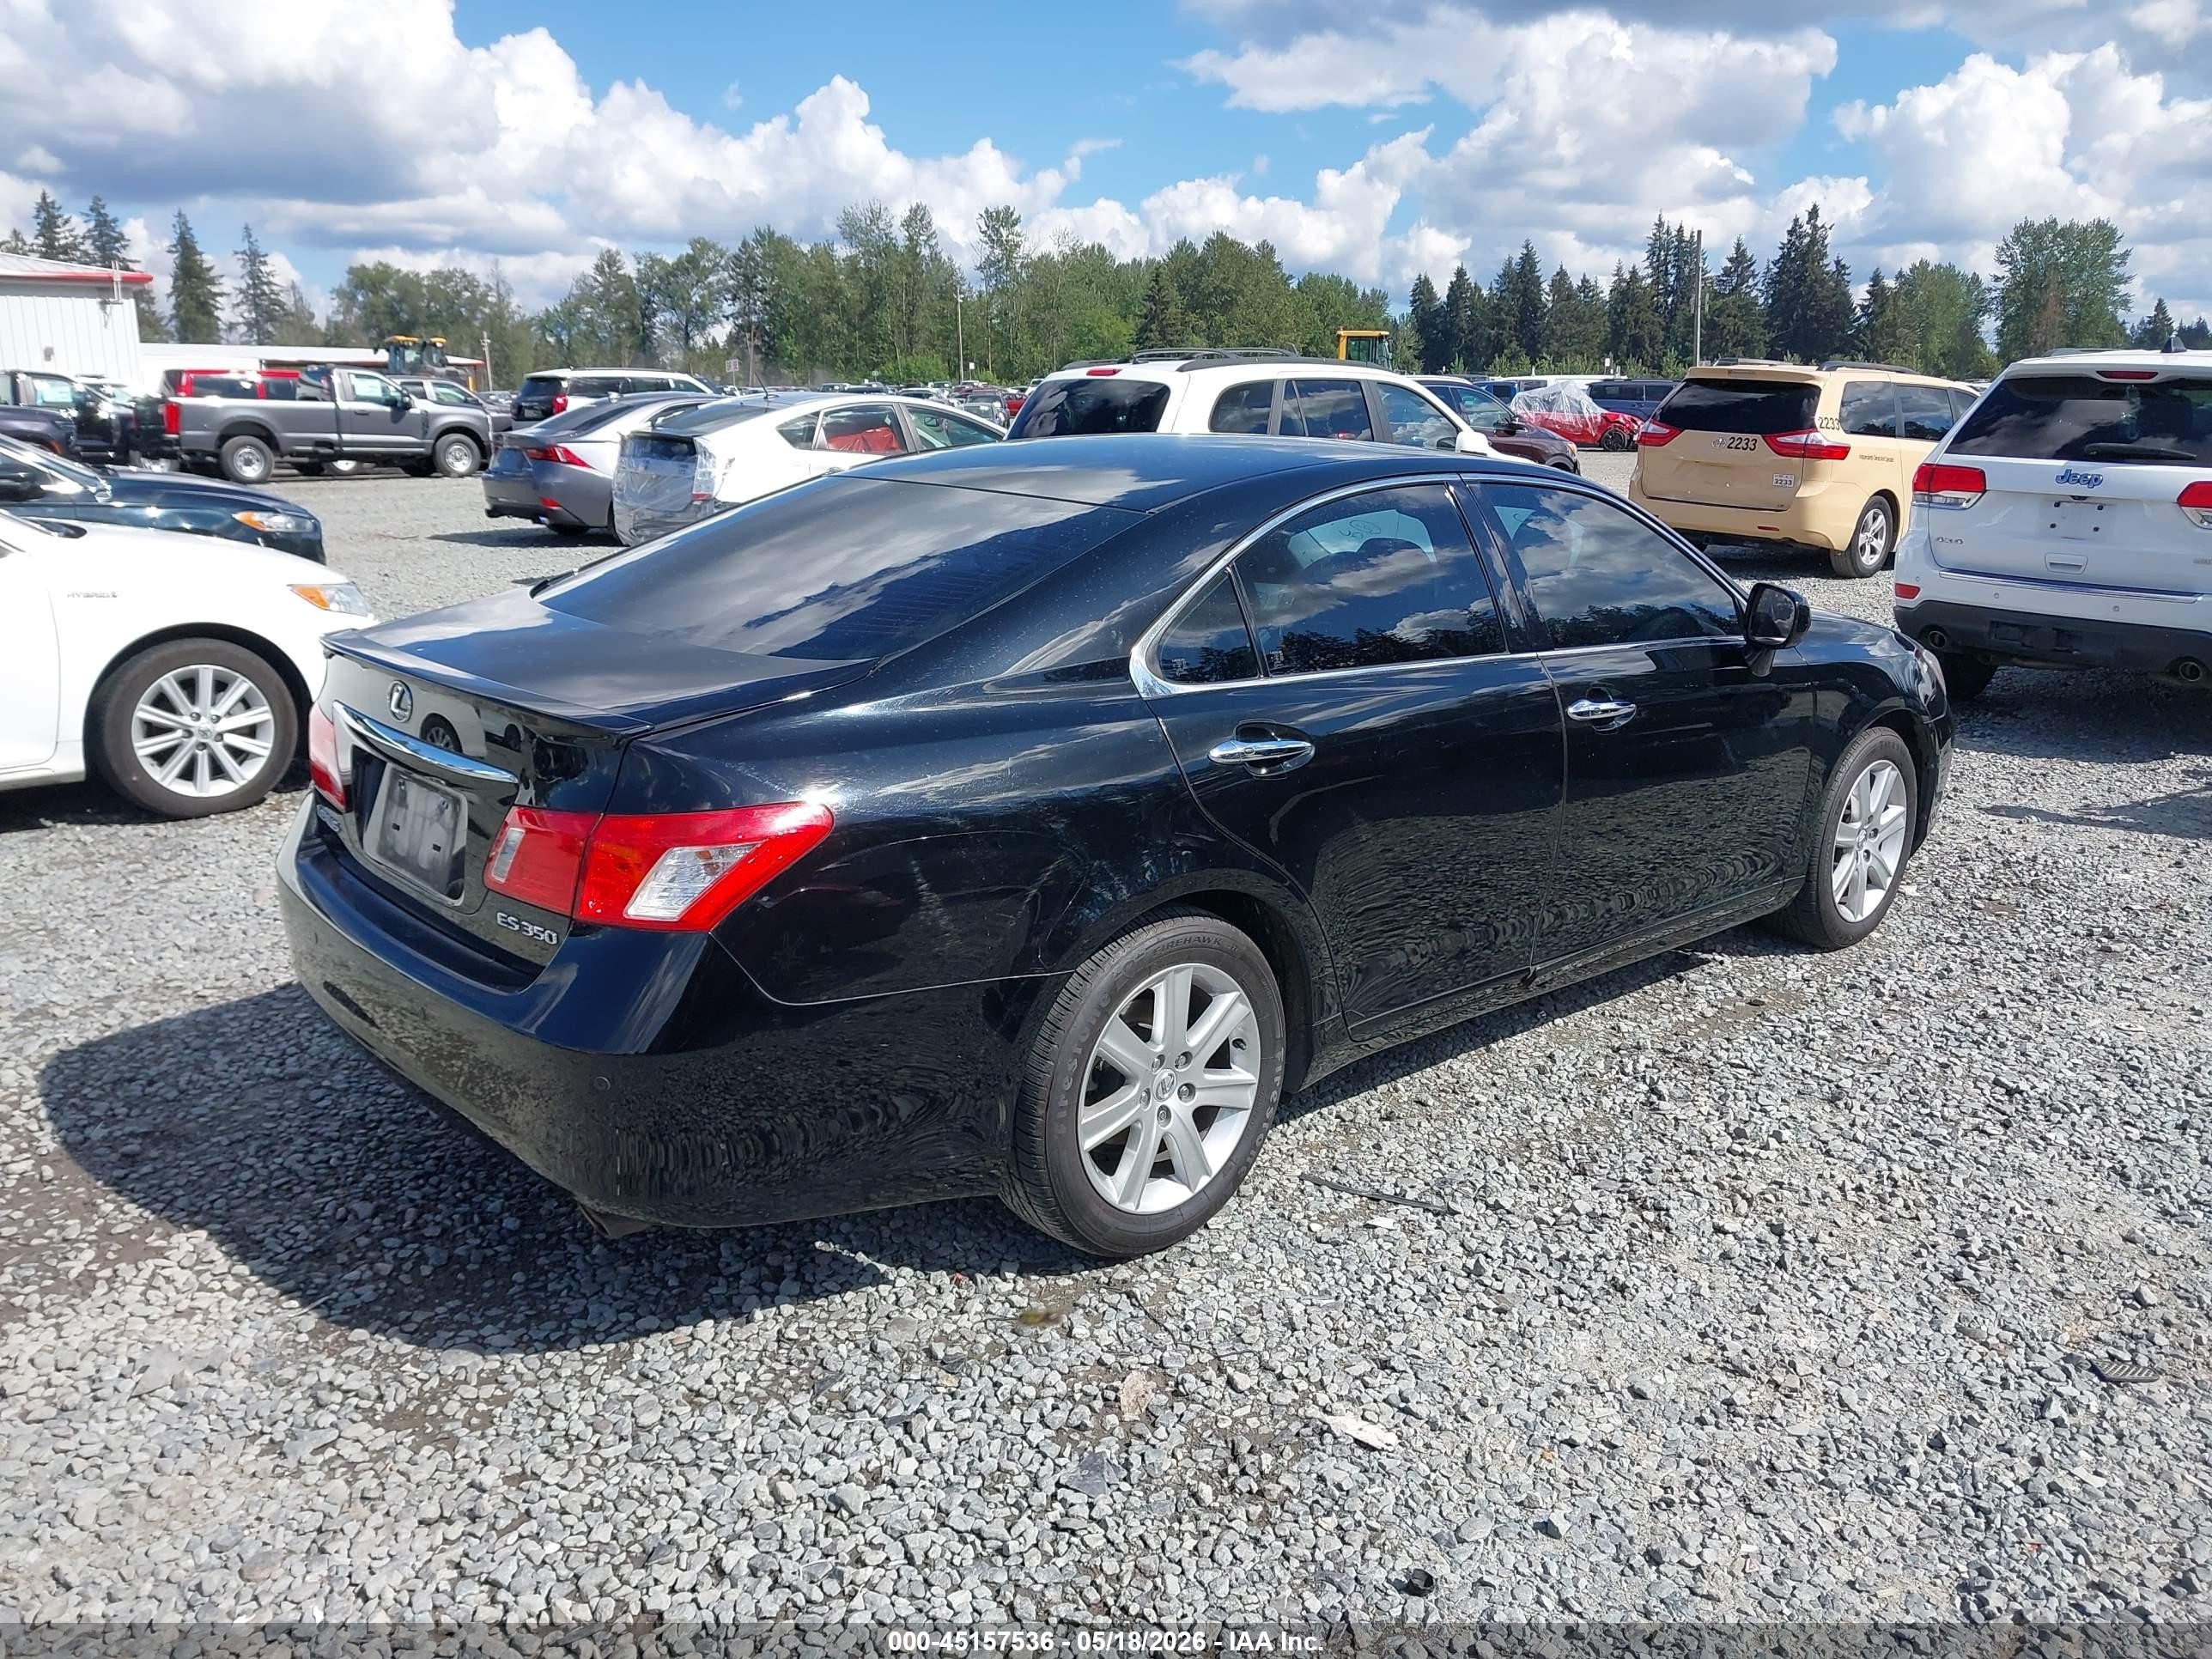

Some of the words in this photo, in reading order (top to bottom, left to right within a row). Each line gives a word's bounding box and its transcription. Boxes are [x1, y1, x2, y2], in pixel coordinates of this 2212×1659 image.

[1818, 416, 1840, 431] 2233
[1727, 436, 1758, 451] 2233
[2056, 468, 2103, 489] Jeep
[496, 912, 520, 931] ES
[521, 921, 557, 945] 350
